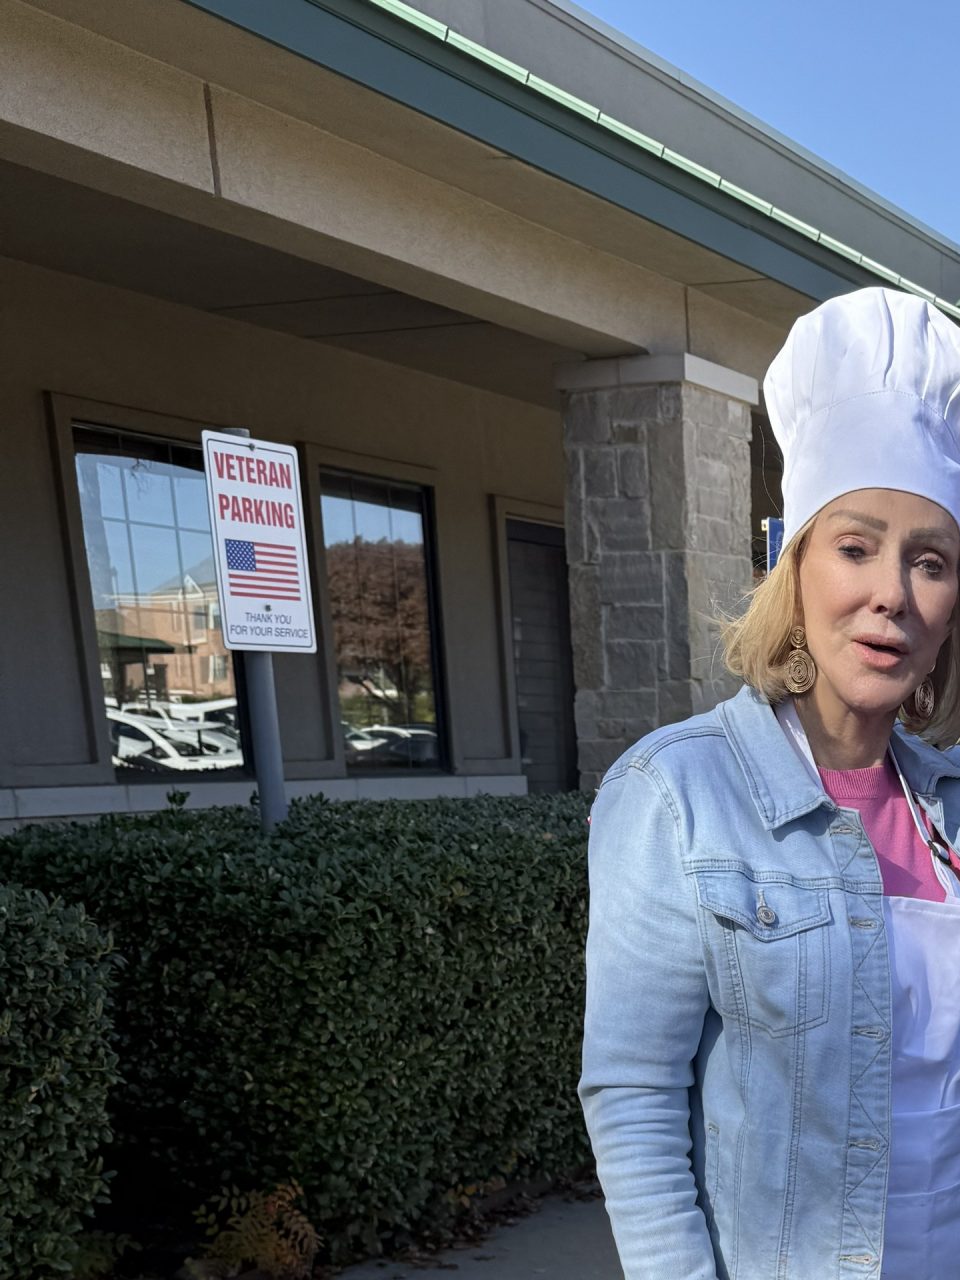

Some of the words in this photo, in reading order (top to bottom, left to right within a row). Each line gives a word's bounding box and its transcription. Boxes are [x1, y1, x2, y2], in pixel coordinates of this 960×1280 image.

[213, 451, 293, 490] VETERAN
[218, 493, 296, 529] PARKING
[245, 612, 273, 624] THANK
[274, 614, 292, 625] YOU
[230, 624, 248, 636] FOR
[249, 626, 273, 637] YOUR
[274, 627, 309, 639] SERVICE
